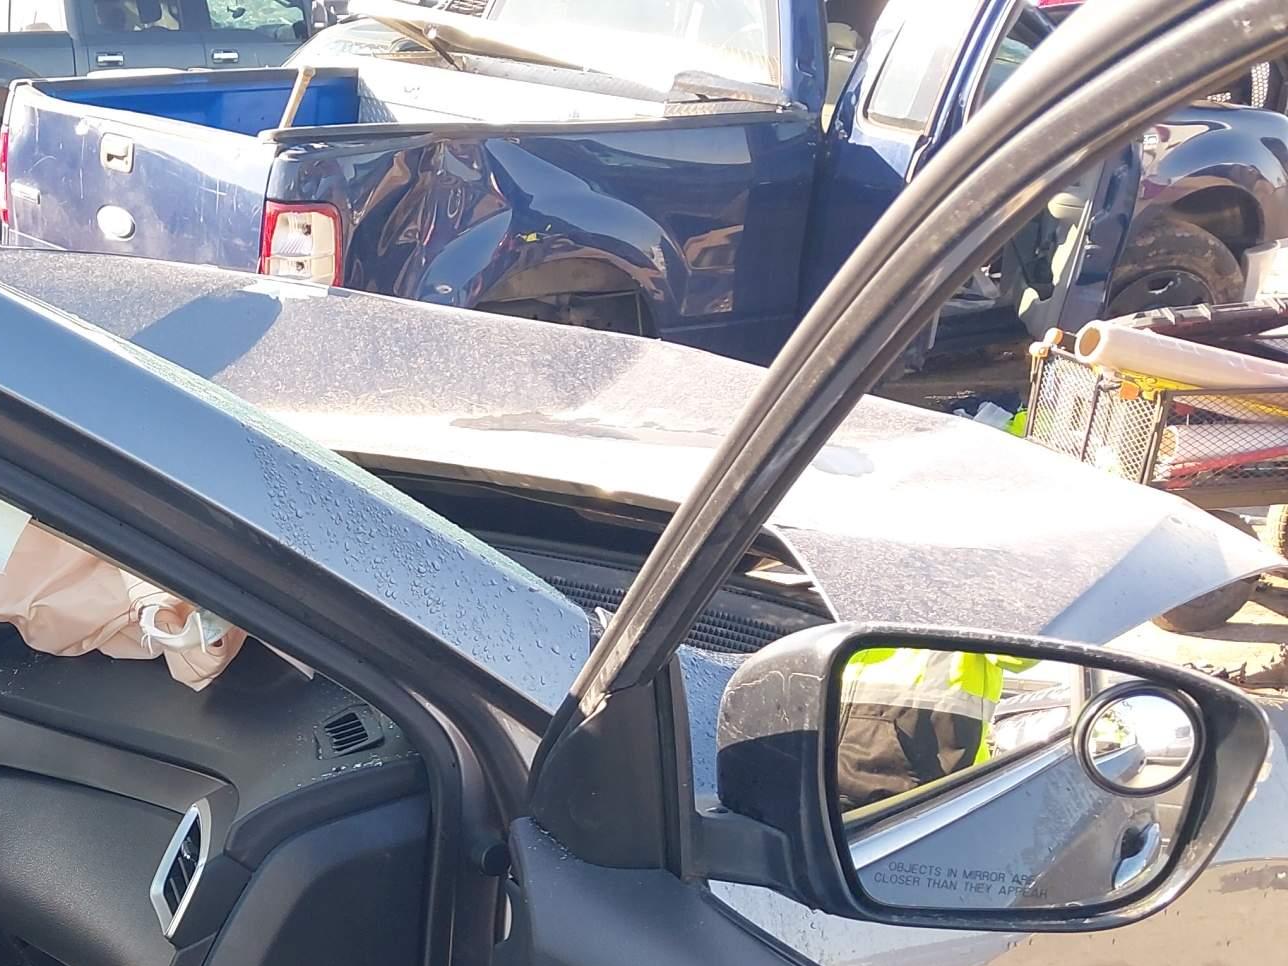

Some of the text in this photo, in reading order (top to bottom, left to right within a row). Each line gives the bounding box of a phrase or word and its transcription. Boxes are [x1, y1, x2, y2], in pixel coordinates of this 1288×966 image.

[874, 872, 920, 888] CLOSER
[927, 877, 958, 890] THAN
[964, 882, 992, 894] THEY
[888, 861, 942, 877] OBJECTS
[947, 868, 958, 878] IN
[963, 869, 1006, 883] MIRROR
